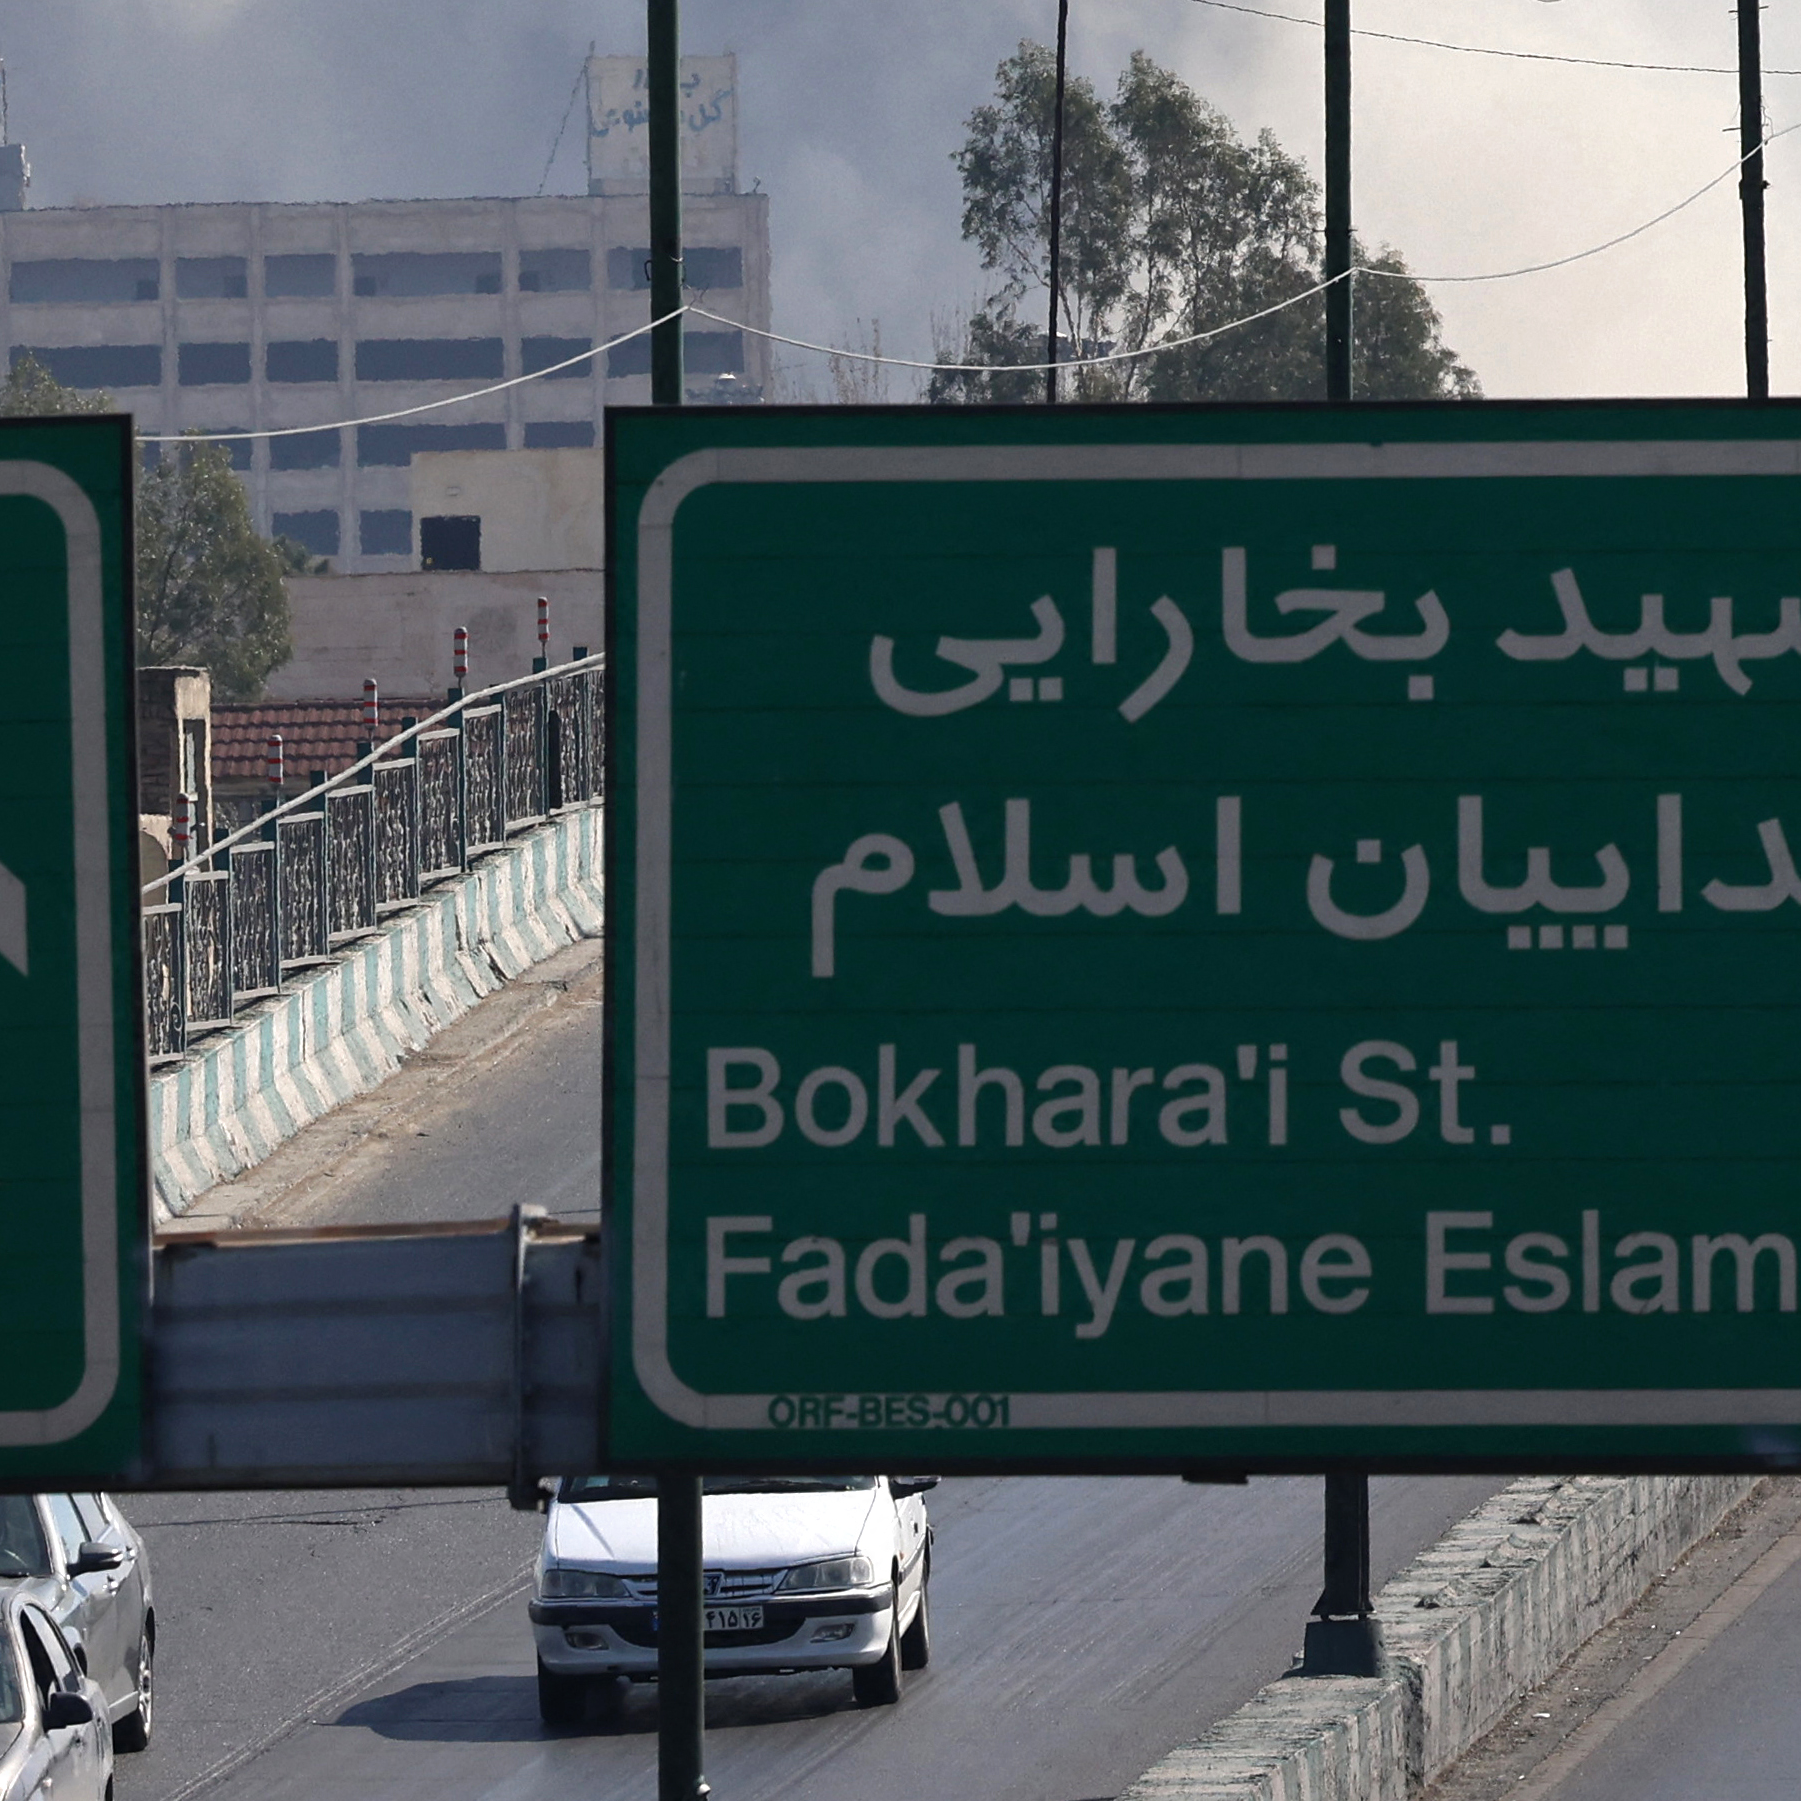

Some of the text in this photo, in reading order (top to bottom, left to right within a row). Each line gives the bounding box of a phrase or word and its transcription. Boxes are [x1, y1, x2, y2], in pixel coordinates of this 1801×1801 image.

[870, 545, 1450, 722] بخارایی
[812, 796, 1241, 977] اسلام
[708, 1041, 1510, 1148] Bokhara'i St.
[707, 1212, 1372, 1338] Fada'iyane
[1427, 1210, 1796, 1313] Eslam
[768, 1393, 1011, 1429] ORF-BES-001
